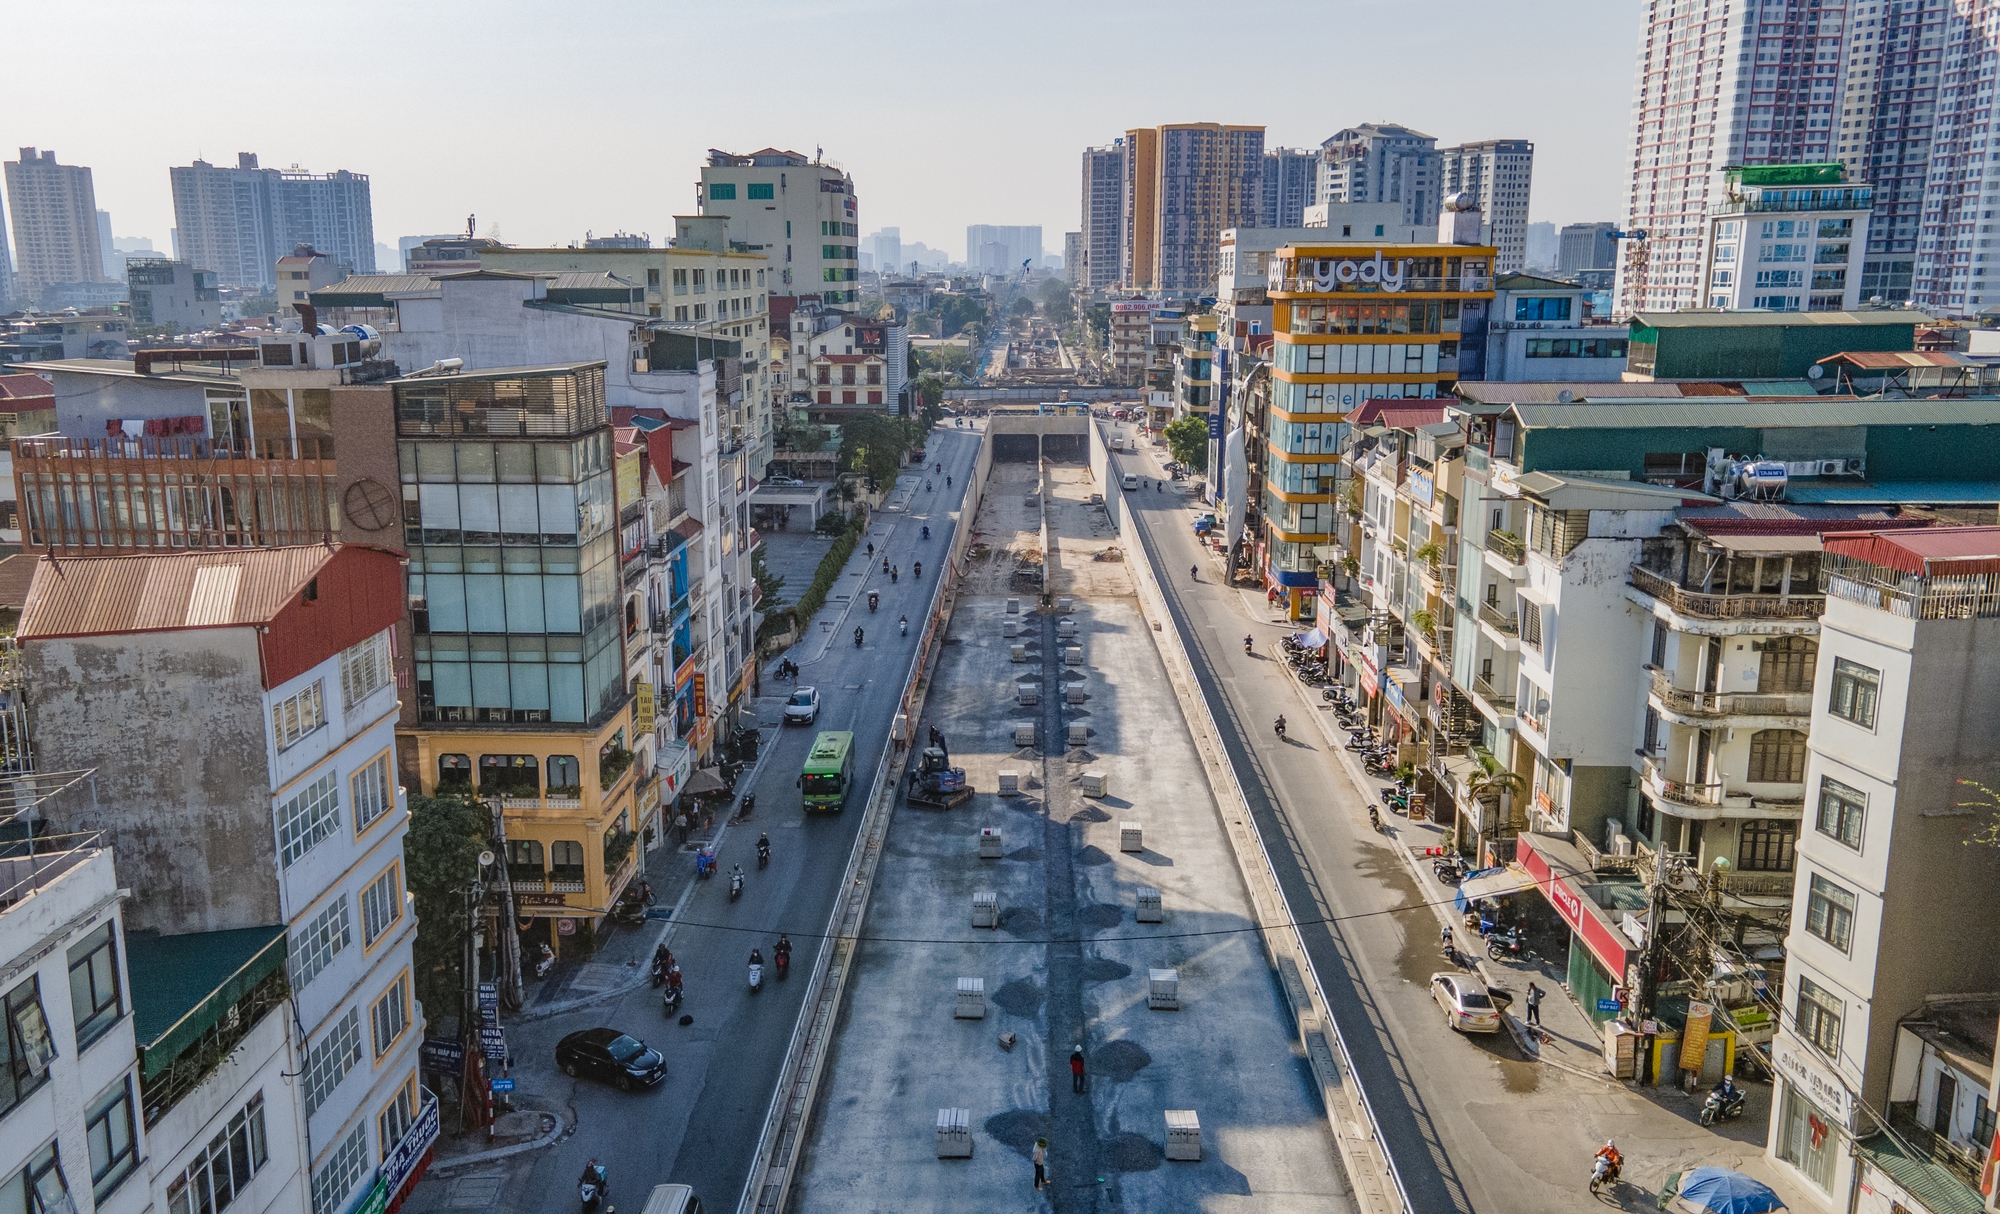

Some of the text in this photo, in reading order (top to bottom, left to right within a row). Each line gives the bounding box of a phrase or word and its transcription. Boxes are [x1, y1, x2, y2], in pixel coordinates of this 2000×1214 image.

[1313, 250, 1404, 293] yody
[697, 704, 703, 714] 6
[1554, 883, 1572, 909] CIRCLE
[406, 1108, 437, 1153] THUỐC
